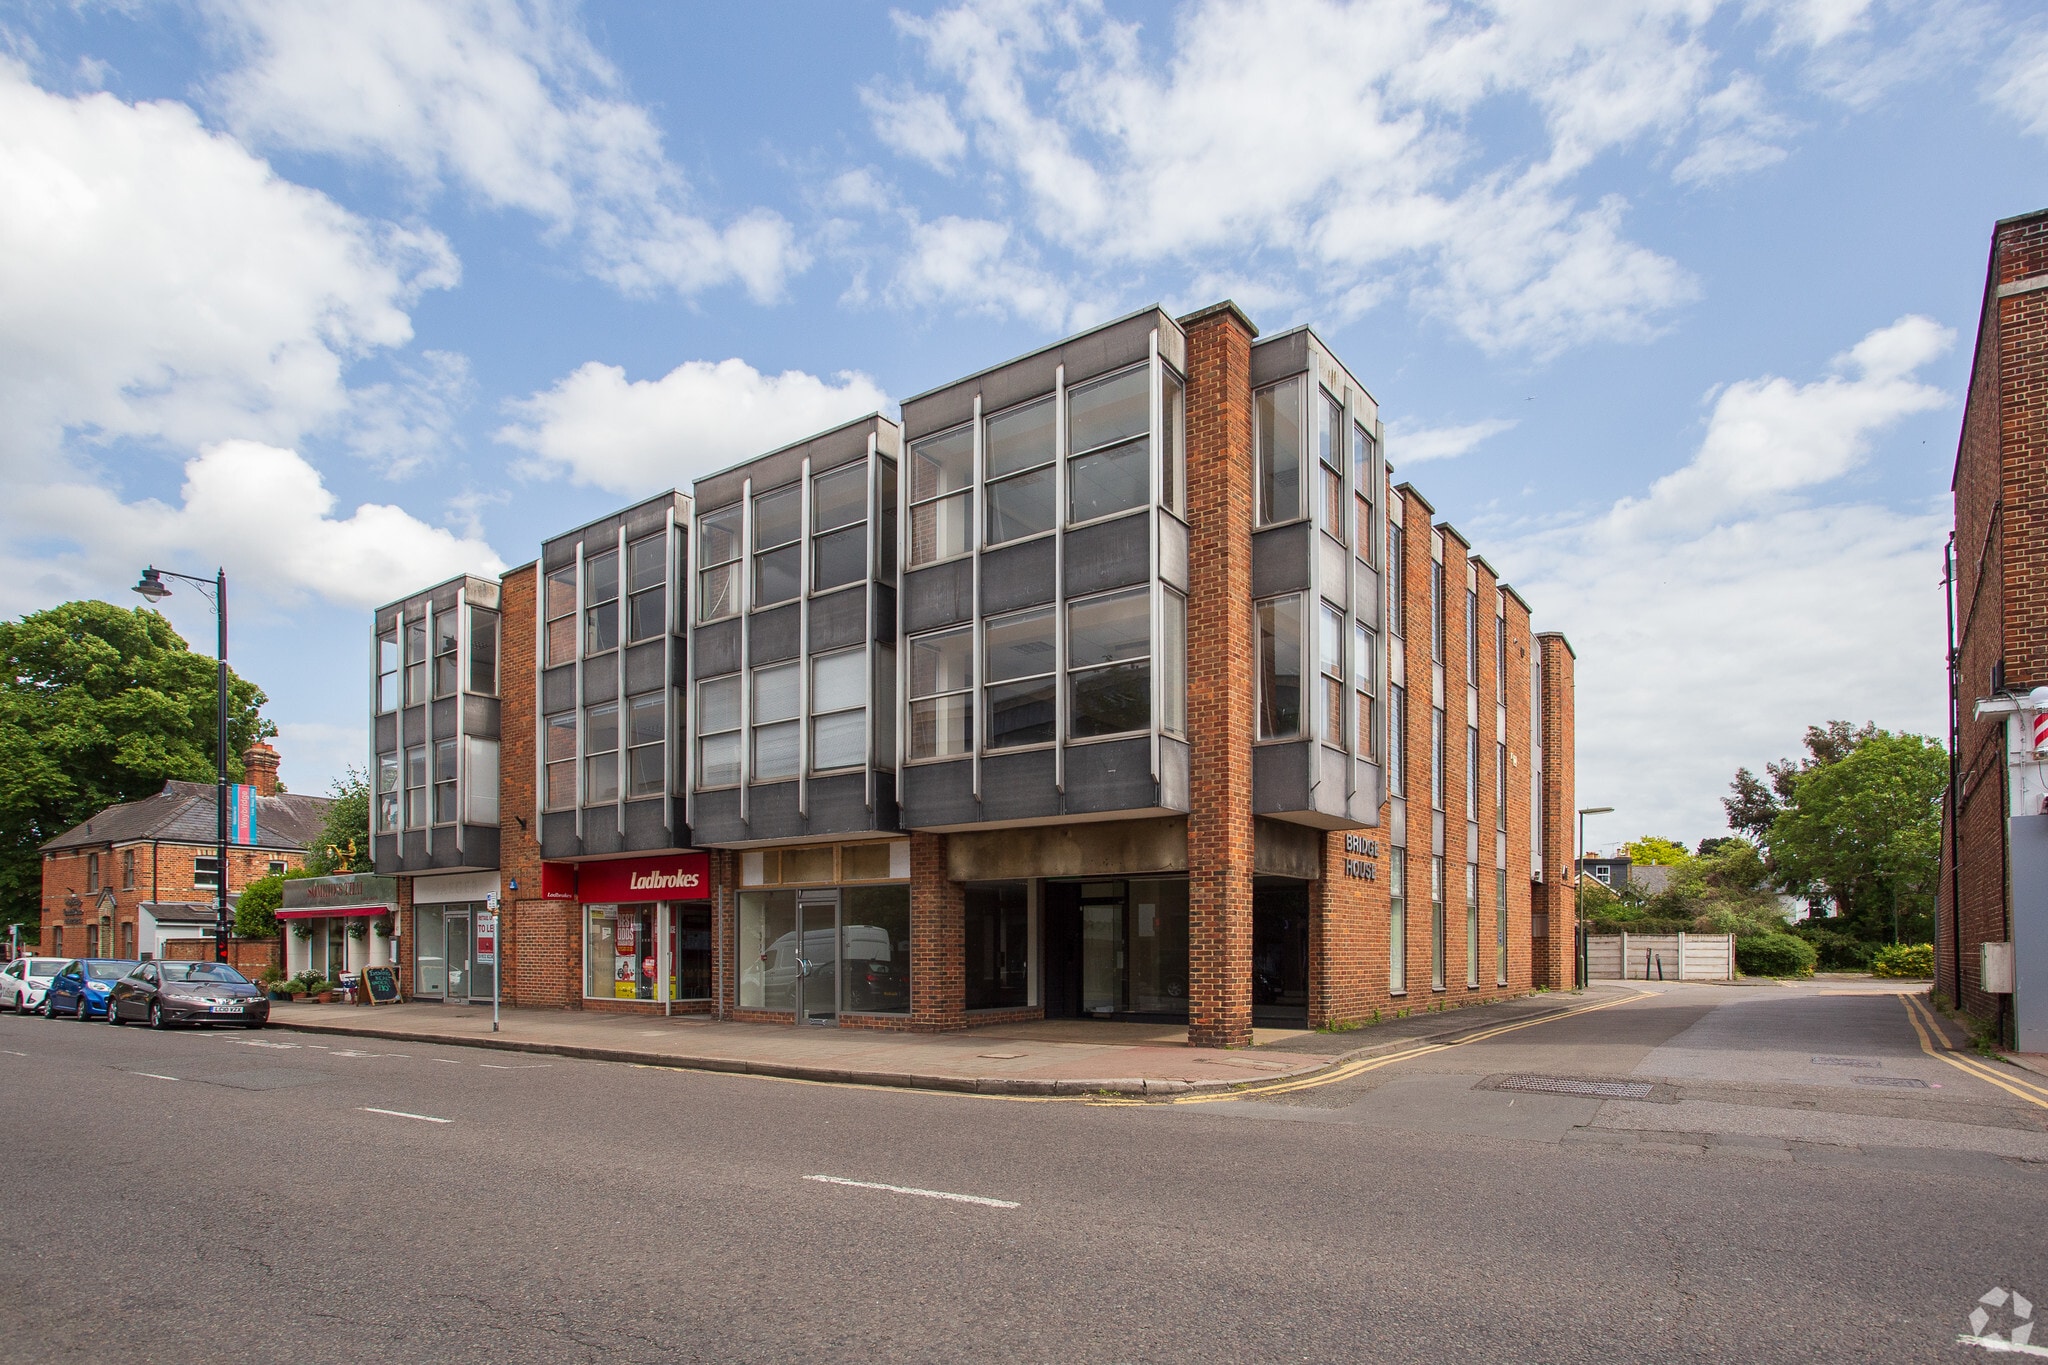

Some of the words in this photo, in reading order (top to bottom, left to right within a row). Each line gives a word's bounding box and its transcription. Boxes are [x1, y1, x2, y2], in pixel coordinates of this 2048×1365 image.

[240, 790, 250, 829] Weybridge
[1345, 833, 1379, 858] BRIDGE
[630, 869, 700, 890] Ladbrokes
[1345, 858, 1376, 880] HOUSE
[478, 924, 486, 933] TO
[486, 924, 494, 933] LE
[617, 913, 634, 928] BEST
[617, 927, 634, 940] ODDS
